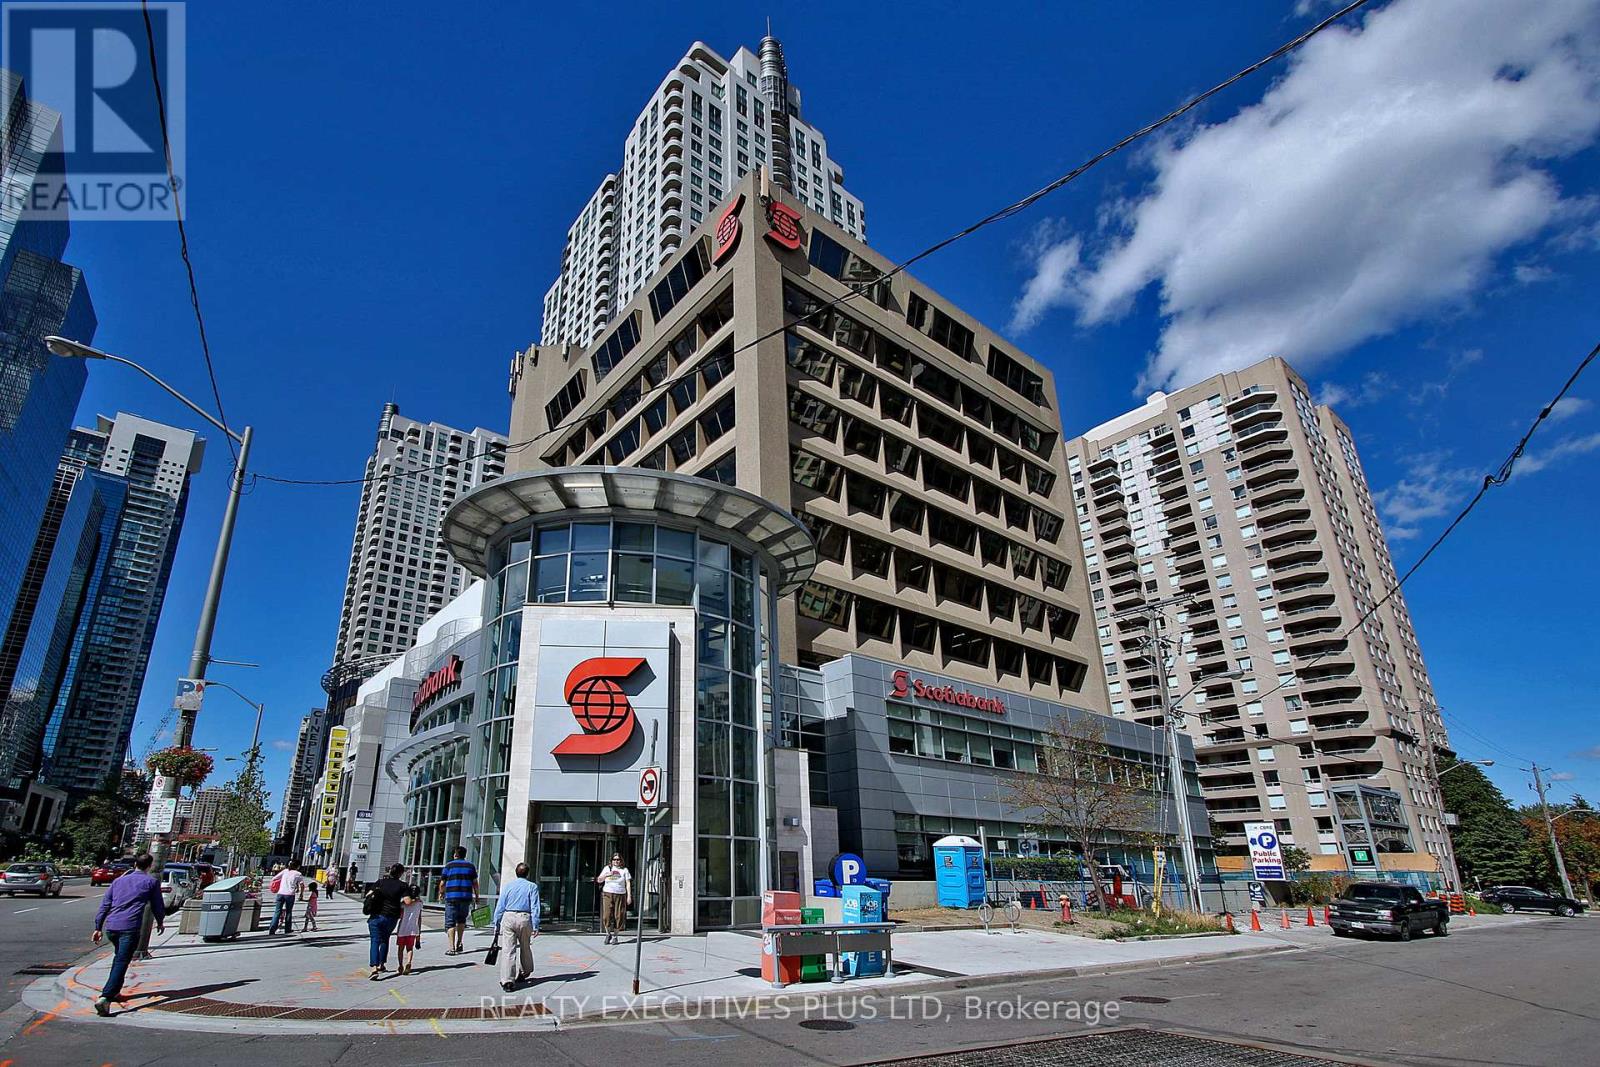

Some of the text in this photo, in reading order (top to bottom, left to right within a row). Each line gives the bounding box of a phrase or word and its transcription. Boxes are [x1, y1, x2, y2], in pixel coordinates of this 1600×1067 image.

[913, 679, 1006, 714] Scotiabank
[303, 710, 322, 773] CINEPLEX
[329, 751, 342, 790] BEST
[323, 796, 336, 826] BUY
[842, 860, 859, 884] P
